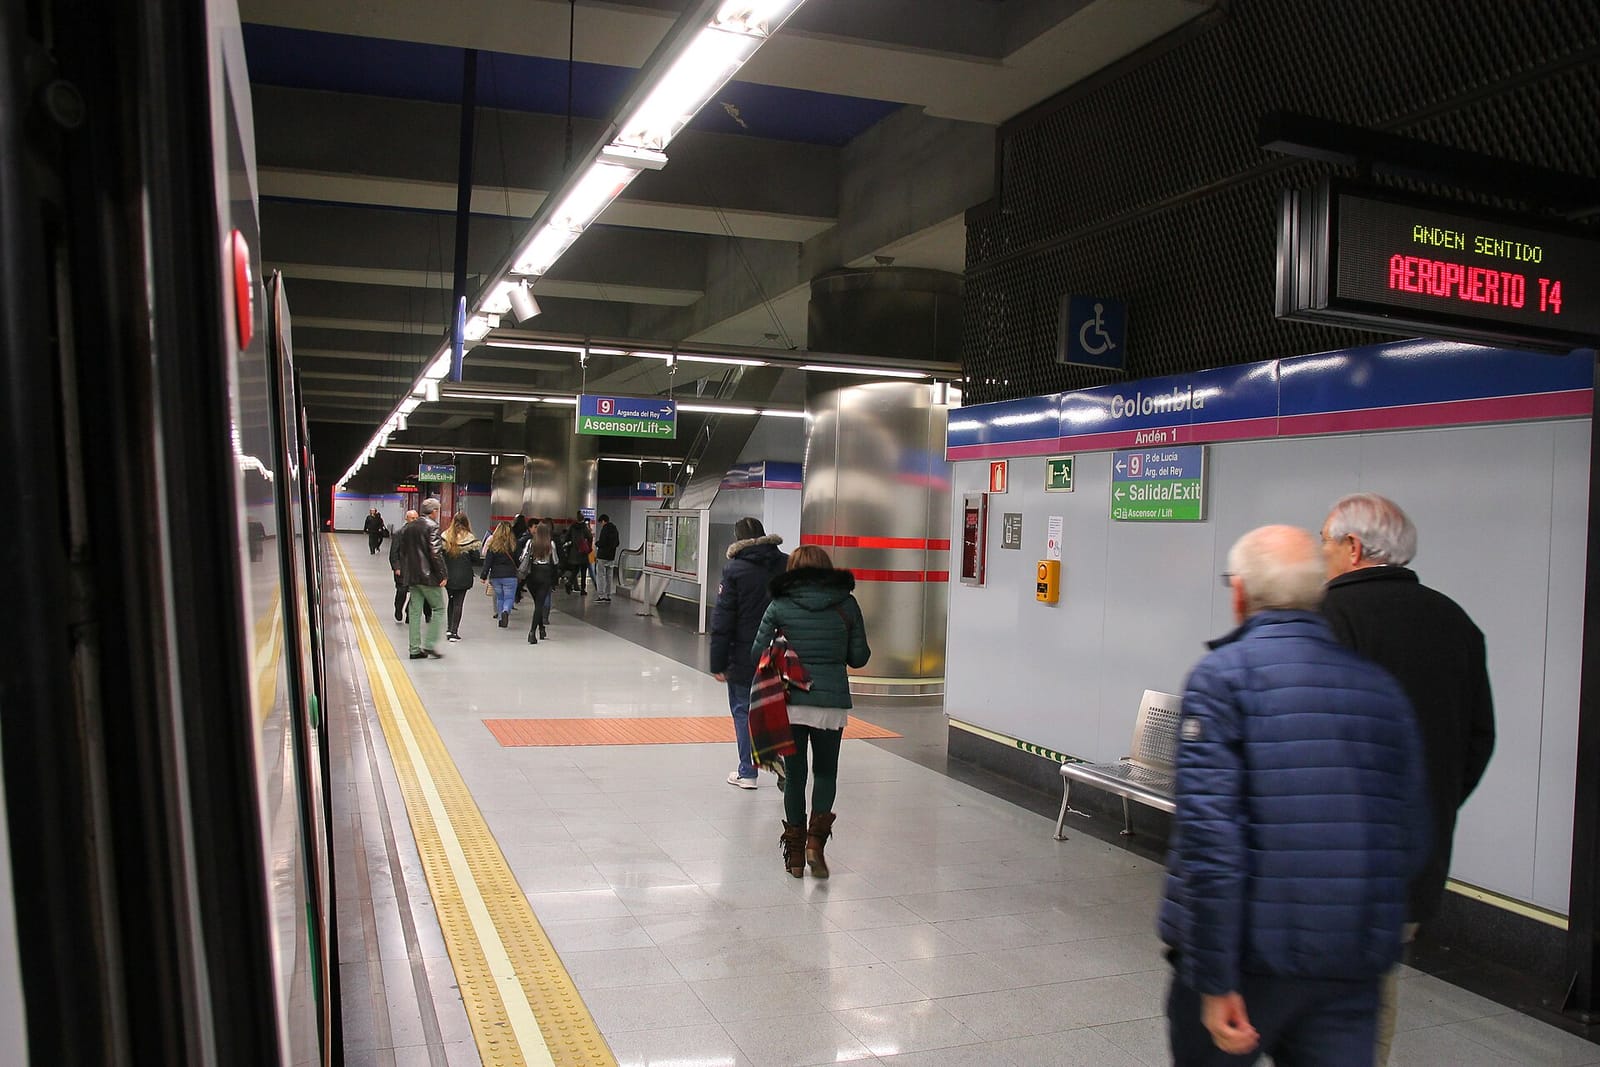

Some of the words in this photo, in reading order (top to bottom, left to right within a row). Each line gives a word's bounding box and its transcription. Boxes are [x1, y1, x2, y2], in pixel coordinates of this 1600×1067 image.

[1413, 224, 1465, 250] ANDEN
[1474, 235, 1542, 264] SENTIDO
[1389, 254, 1525, 308] AEROPUERTO
[1538, 277, 1562, 314] T4
[601, 400, 611, 414] 9
[1110, 384, 1204, 419] Colombia
[617, 409, 639, 418] Arganda
[649, 411, 660, 420] Rey
[584, 418, 659, 434] Ascensor/Lift
[1135, 429, 1167, 444] Andén
[1171, 428, 1177, 441] 1
[1131, 456, 1139, 475] 9
[1145, 454, 1151, 463] P.
[1152, 453, 1160, 462] de
[1145, 467, 1157, 478] Arg.
[1159, 466, 1169, 476] del
[1170, 466, 1183, 477] Rey
[1129, 482, 1201, 501] Salida/Exit
[1128, 508, 1157, 518] Ascensor
[1162, 508, 1173, 518] Lift
